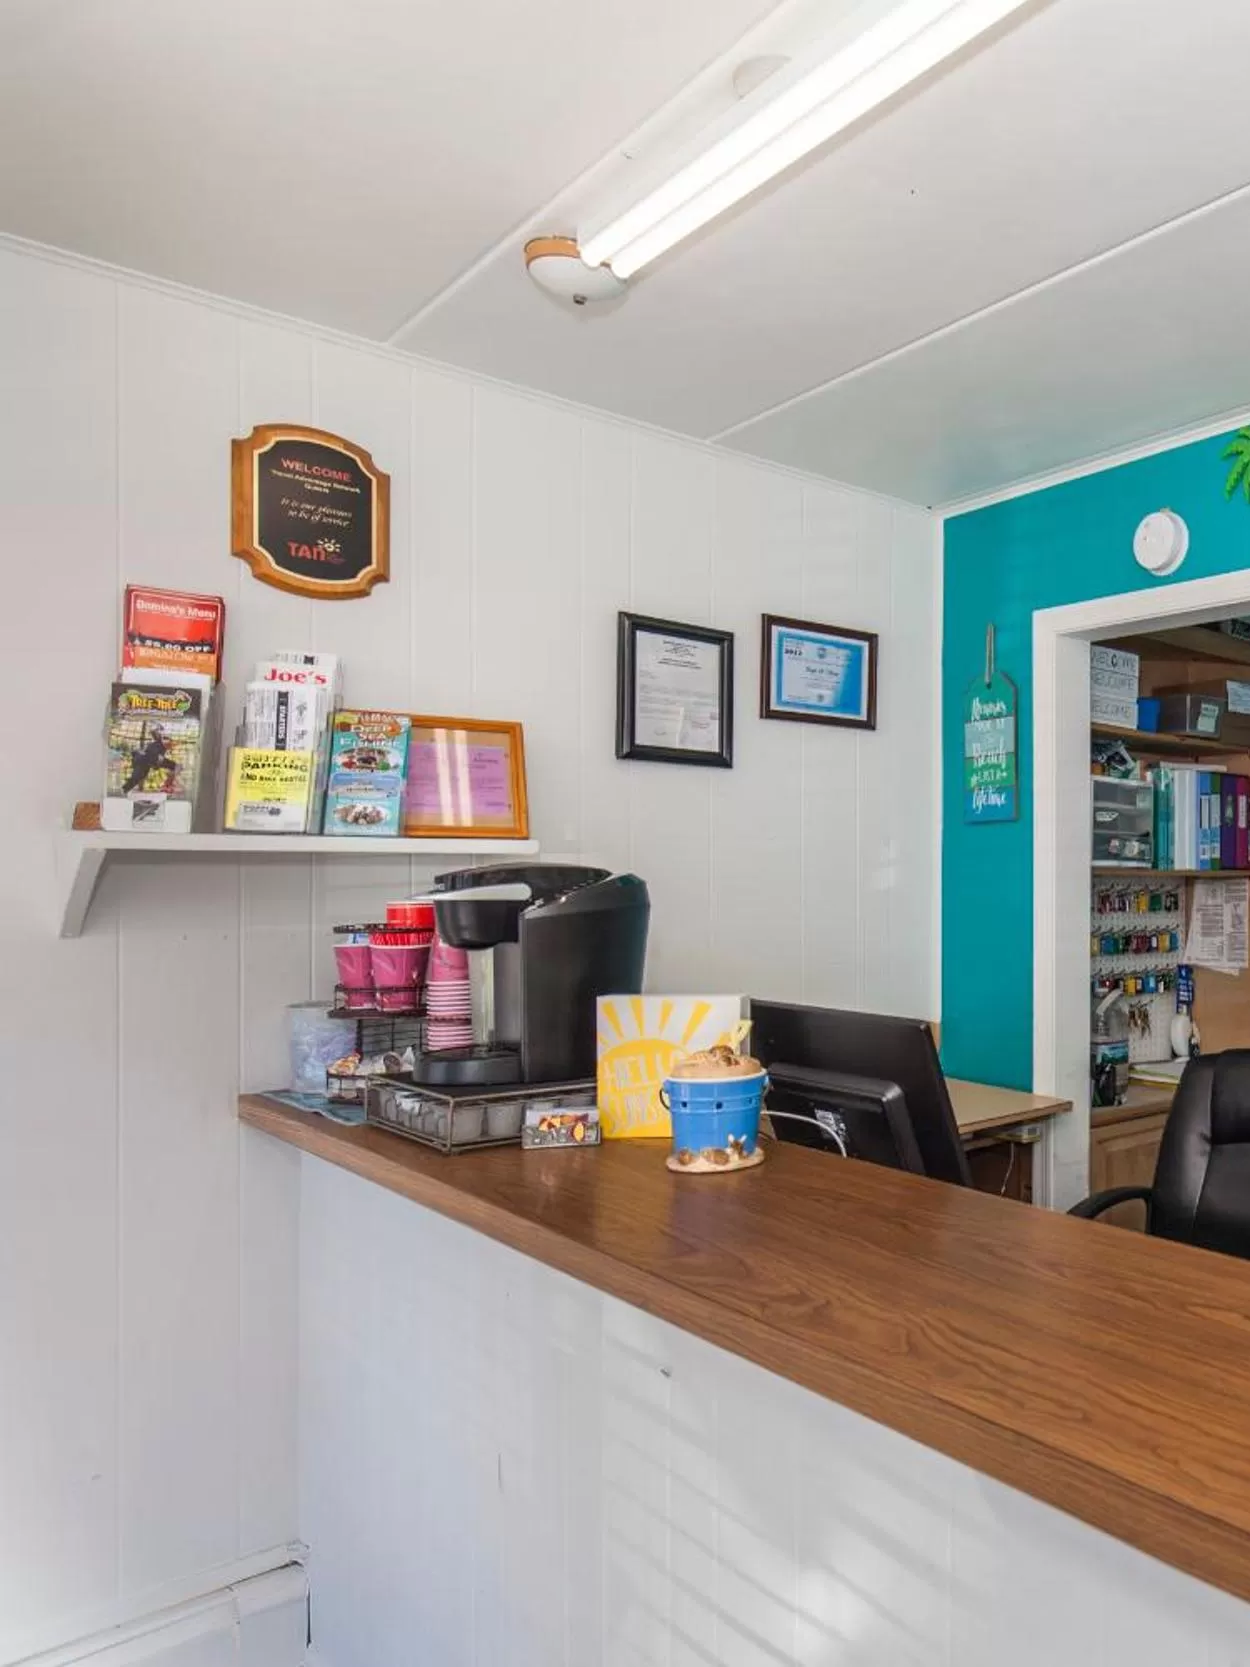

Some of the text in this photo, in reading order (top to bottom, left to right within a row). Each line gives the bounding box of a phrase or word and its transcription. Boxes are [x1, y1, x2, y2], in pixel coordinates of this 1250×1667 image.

[281, 458, 350, 481] WELCOME
[264, 667, 327, 685] Joe's
[1090, 672, 1136, 691] ELCOME
